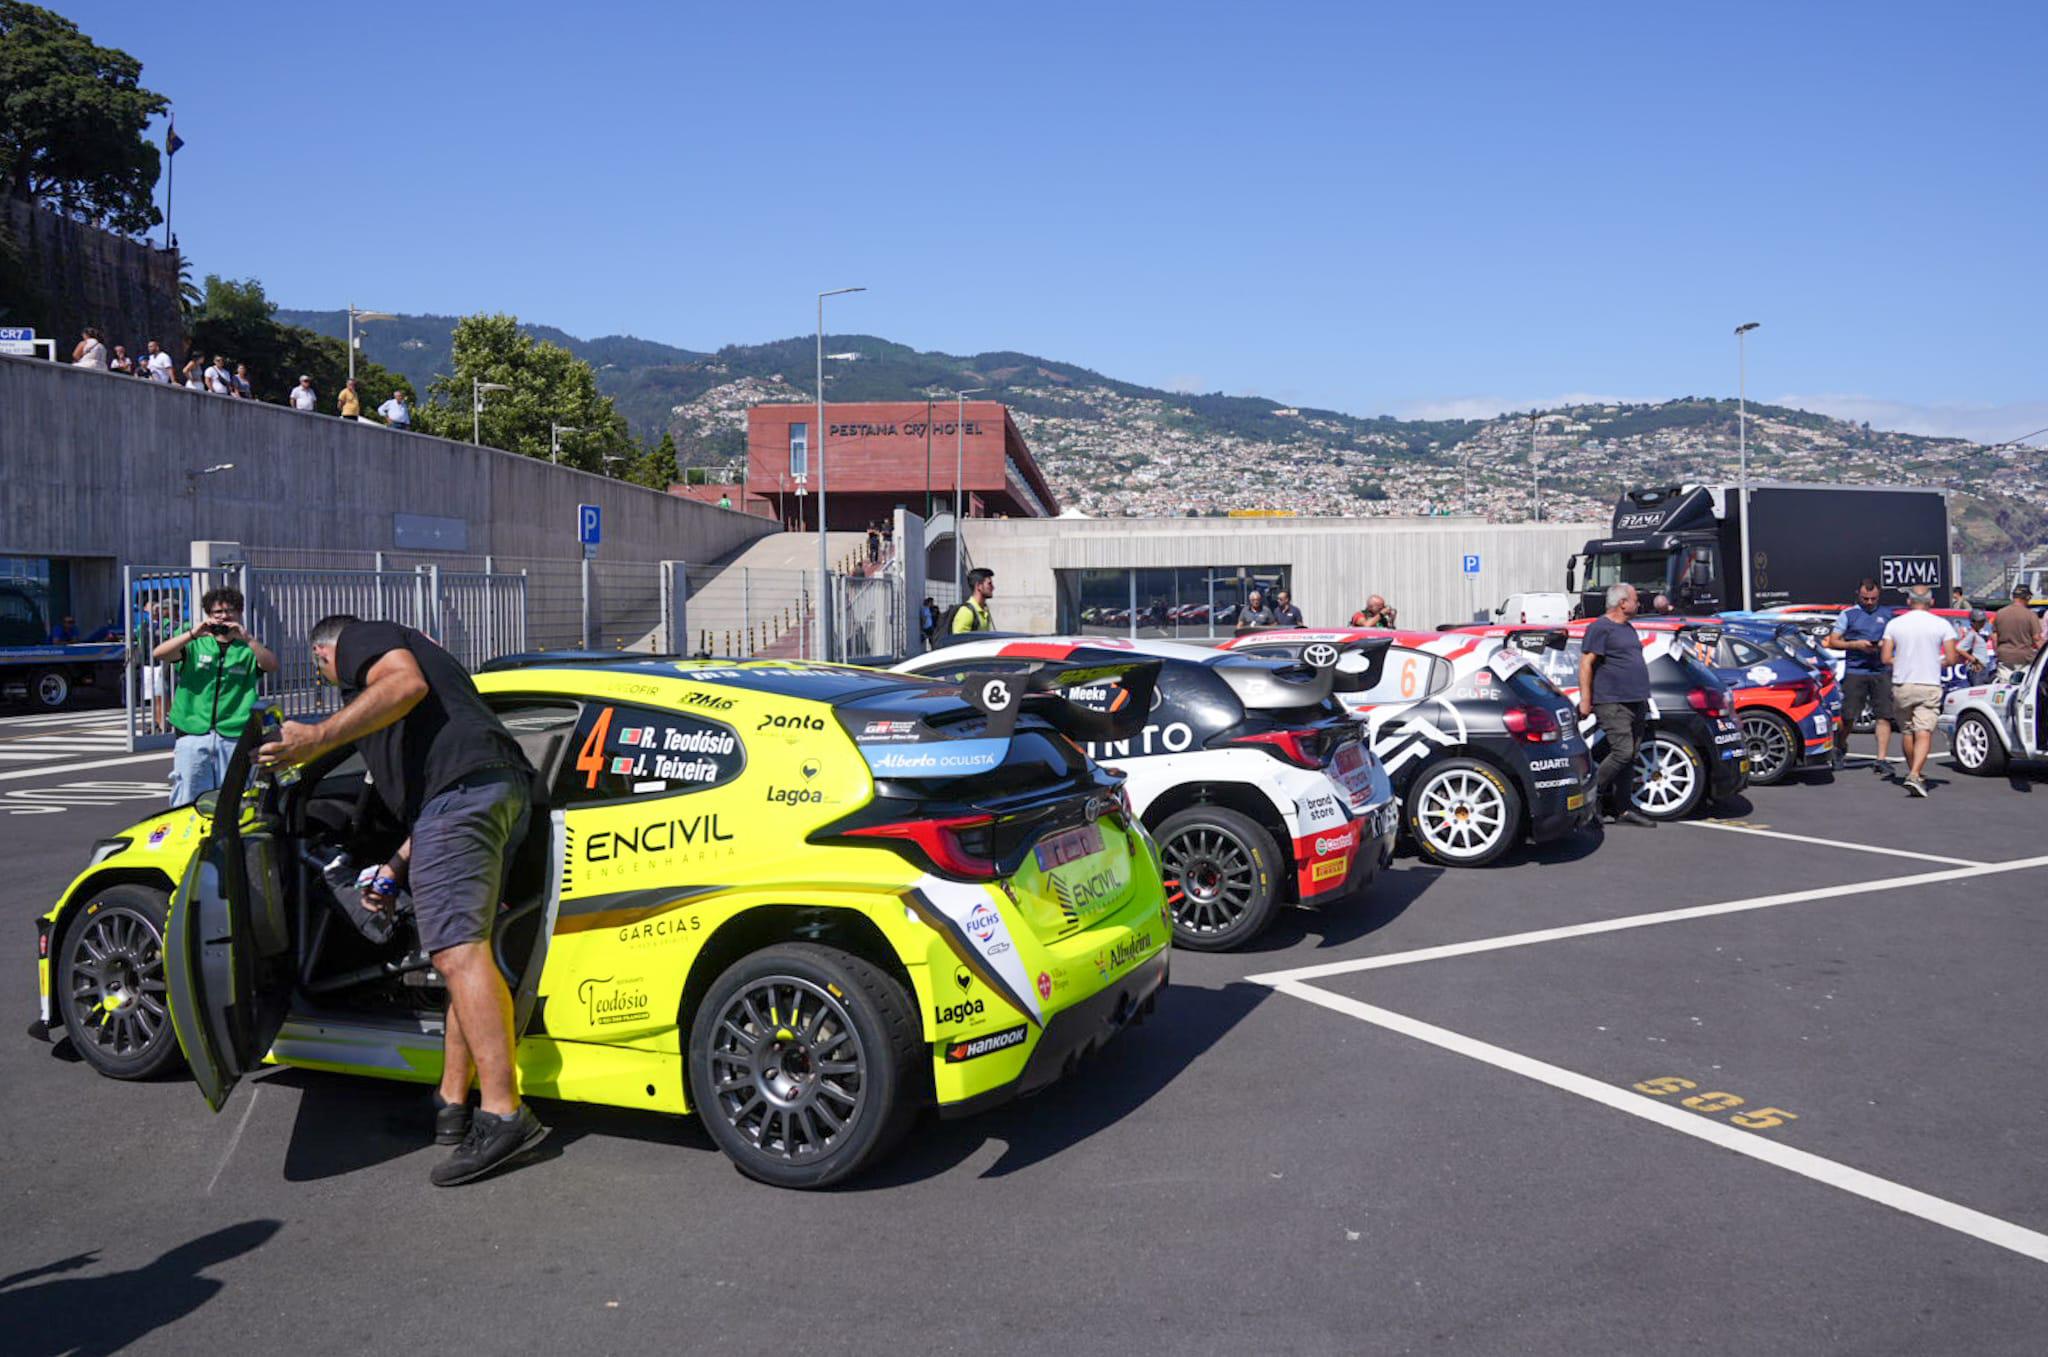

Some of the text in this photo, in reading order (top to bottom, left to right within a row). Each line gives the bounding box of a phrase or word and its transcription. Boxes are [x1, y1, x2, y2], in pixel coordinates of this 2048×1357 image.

[830, 424, 898, 437] PESTANA
[903, 423, 928, 438] CR7
[585, 509, 597, 540] P
[1466, 556, 1477, 571] P
[1884, 560, 1938, 584] BRAMA
[1401, 658, 1417, 698] 6
[1069, 686, 1107, 701] Meeke
[576, 706, 615, 790] 4
[640, 727, 735, 756] R. Teodósio
[633, 755, 718, 783] J. Teixeira
[873, 753, 937, 769] Alberto
[767, 785, 822, 807] Lagoa
[1307, 793, 1333, 808] brand
[1310, 807, 1335, 821] store
[586, 813, 734, 863] ENCIVIL
[586, 846, 736, 881] ENGENHARIA
[1073, 868, 1121, 908] ENCIVIL
[619, 916, 701, 942] GARCIAS
[966, 912, 1000, 934] FUCHS
[935, 999, 985, 1025] Lagoa
[1632, 1076, 1799, 1129] 605
